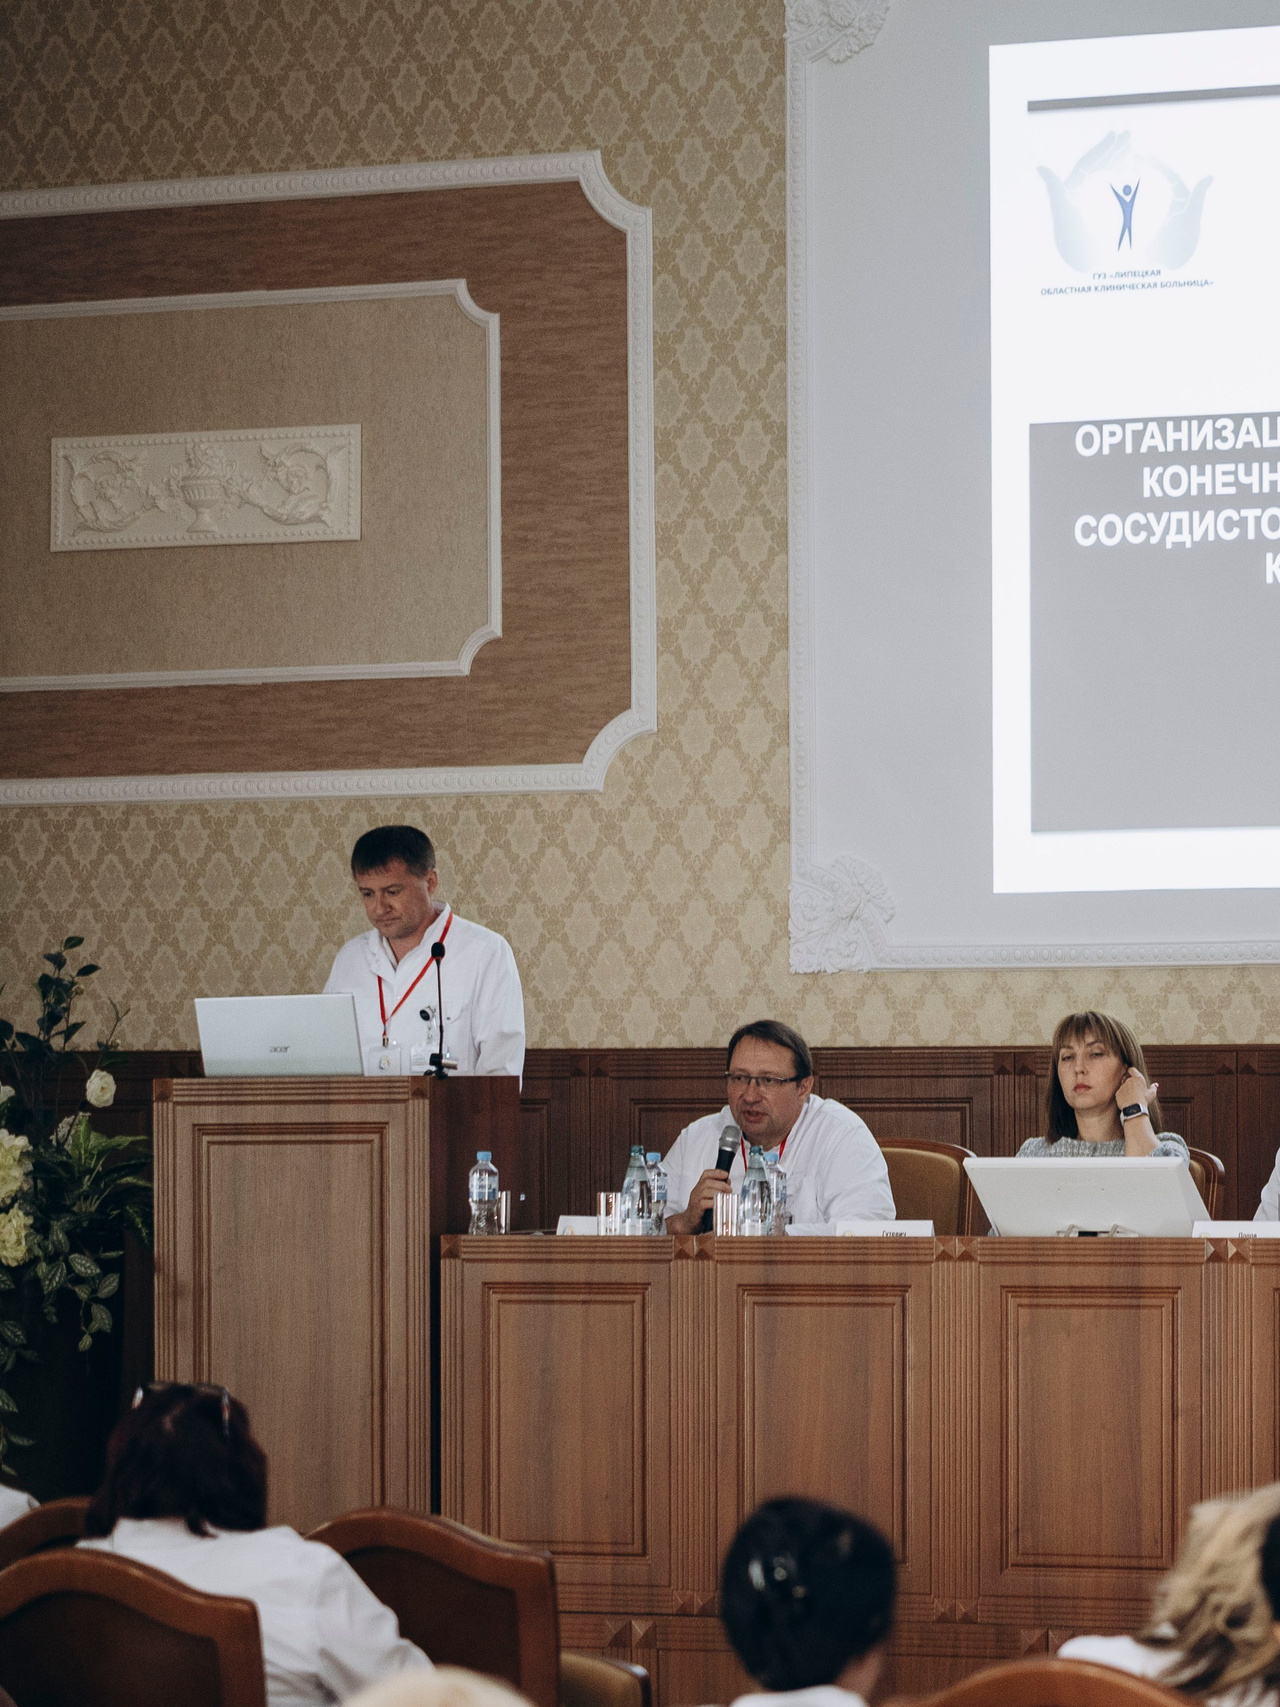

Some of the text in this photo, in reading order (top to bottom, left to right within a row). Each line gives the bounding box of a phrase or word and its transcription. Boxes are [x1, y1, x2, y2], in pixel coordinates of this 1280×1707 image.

[1092, 272, 1108, 281] ГУЗ
[1040, 284, 1092, 296] ОБЛАСТНАЯ
[1094, 281, 1158, 293] КЛИНИЧЕСКАЯ
